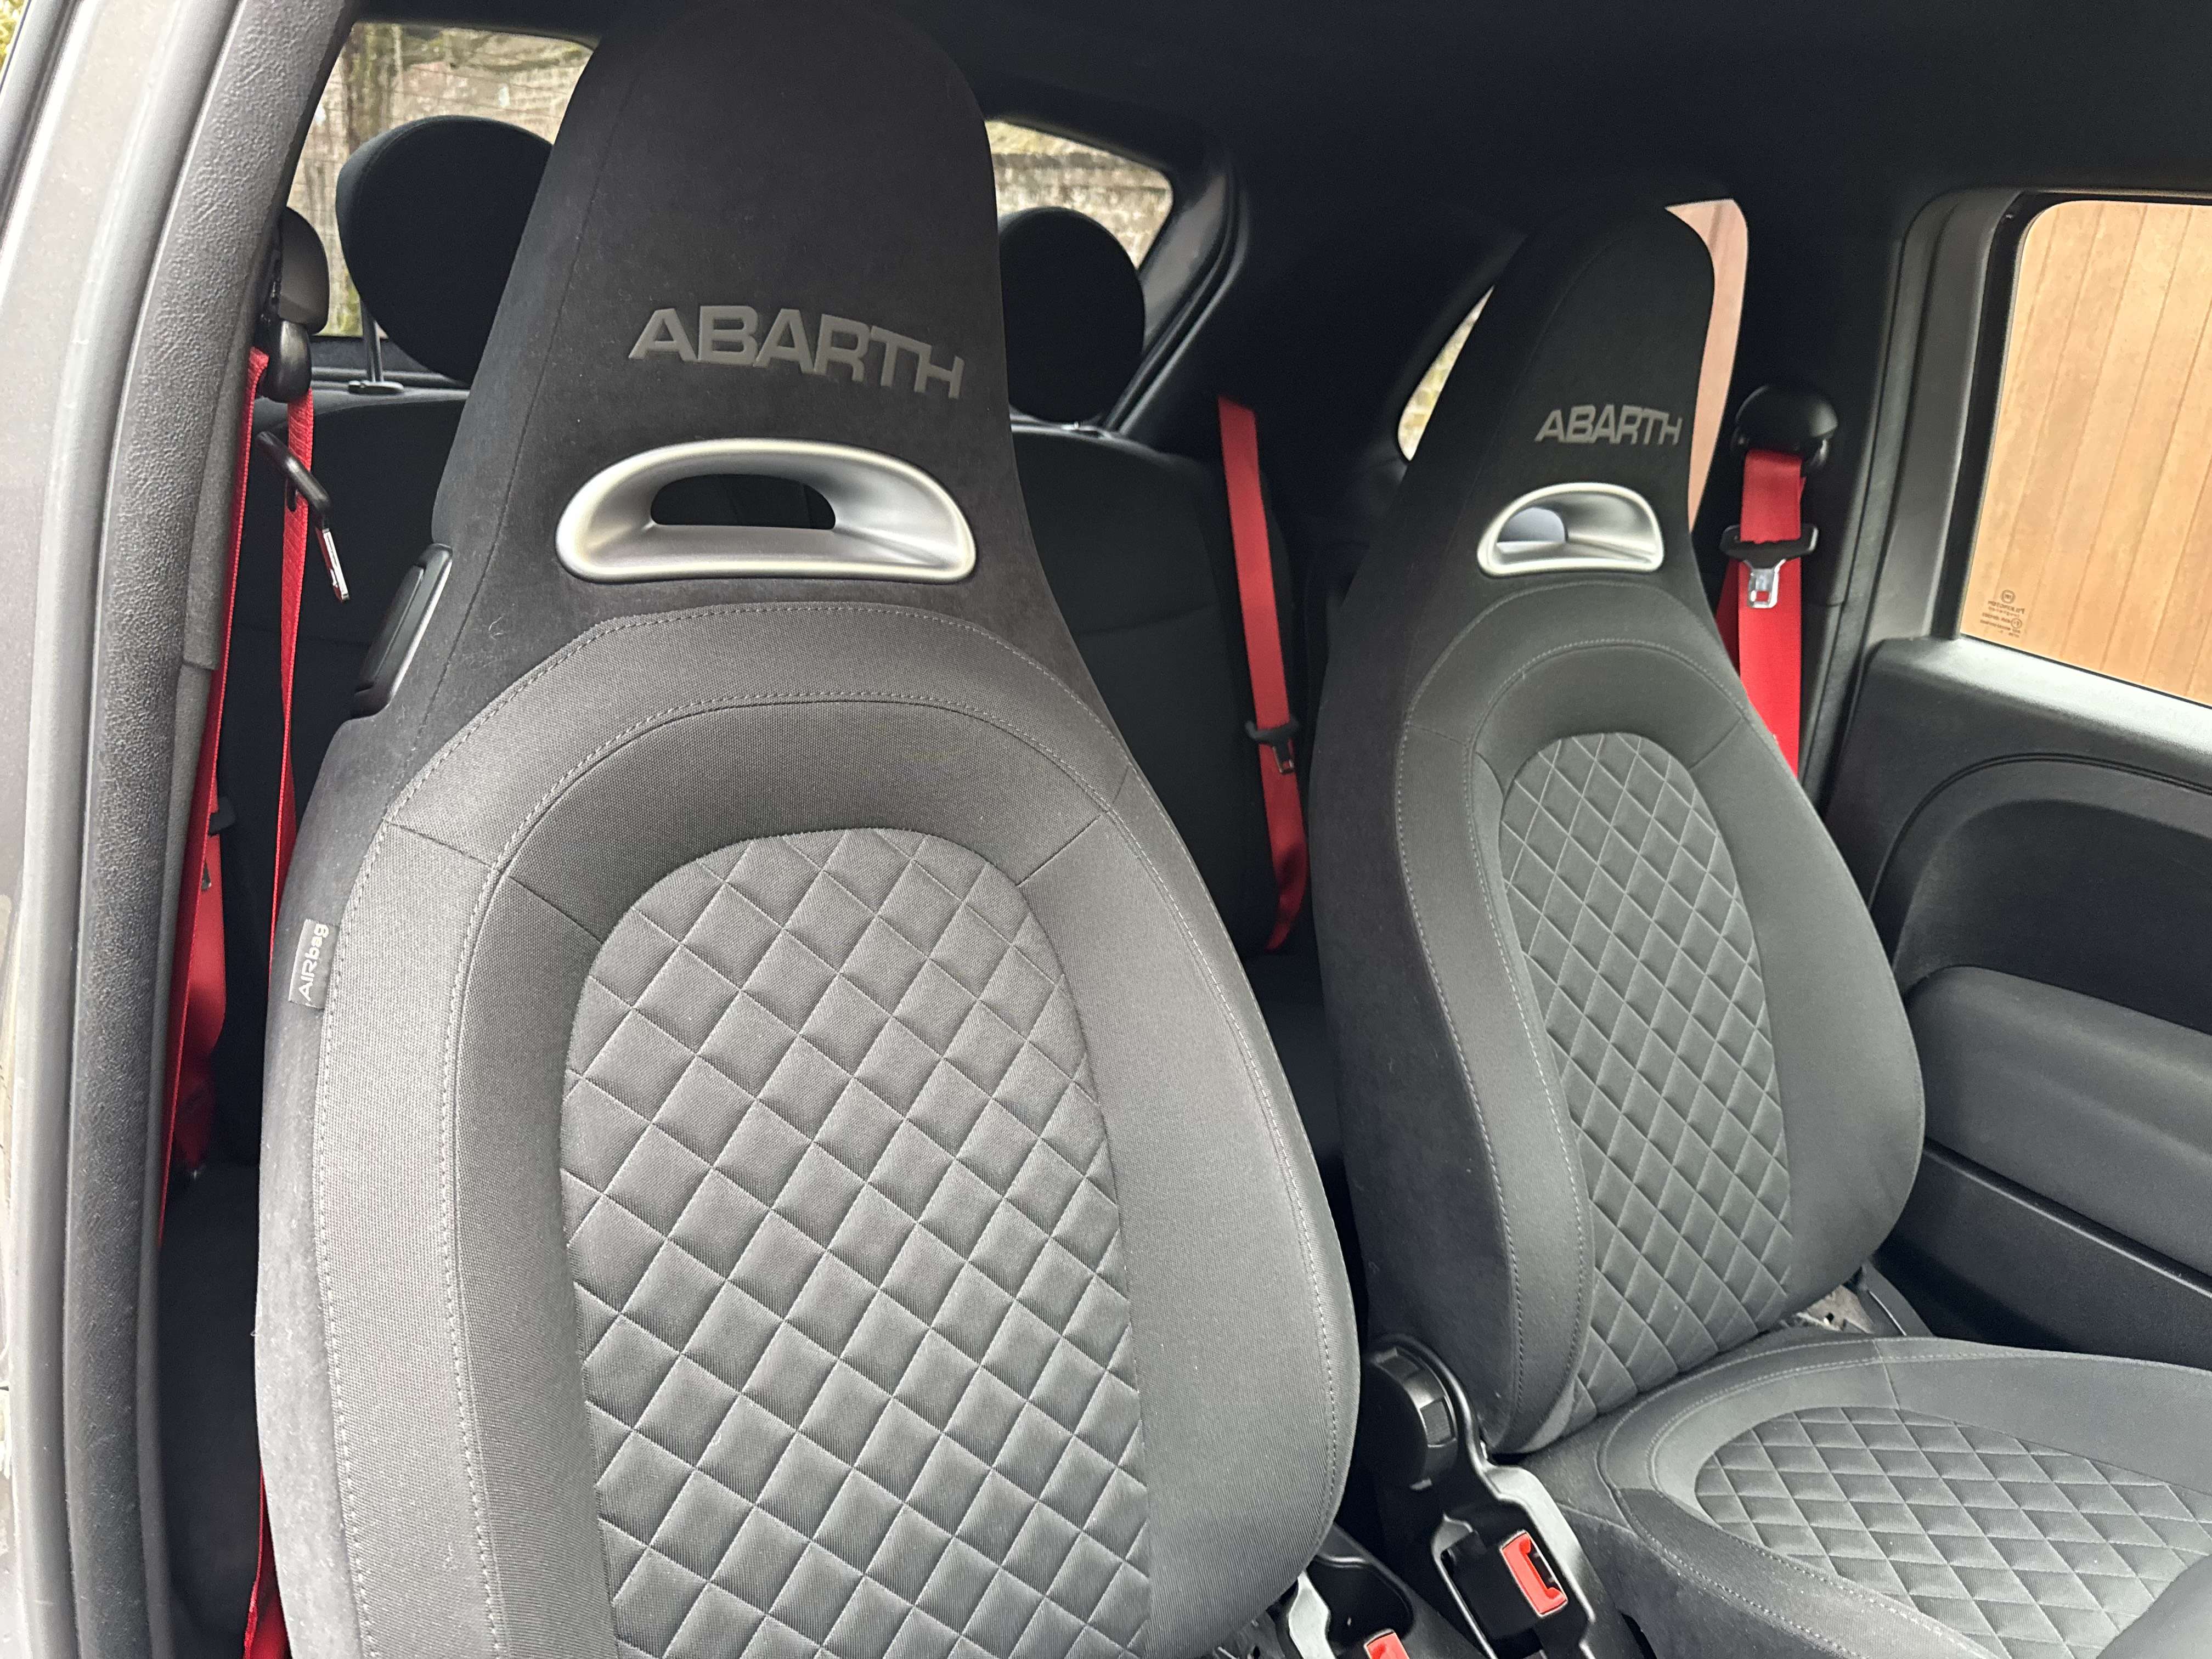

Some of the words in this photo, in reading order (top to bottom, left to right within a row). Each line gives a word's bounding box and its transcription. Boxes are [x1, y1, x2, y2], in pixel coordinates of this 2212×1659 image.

[628, 305, 964, 399] ABARTH
[1534, 404, 1683, 445] ABARTH
[299, 923, 329, 1001] AIRbag
